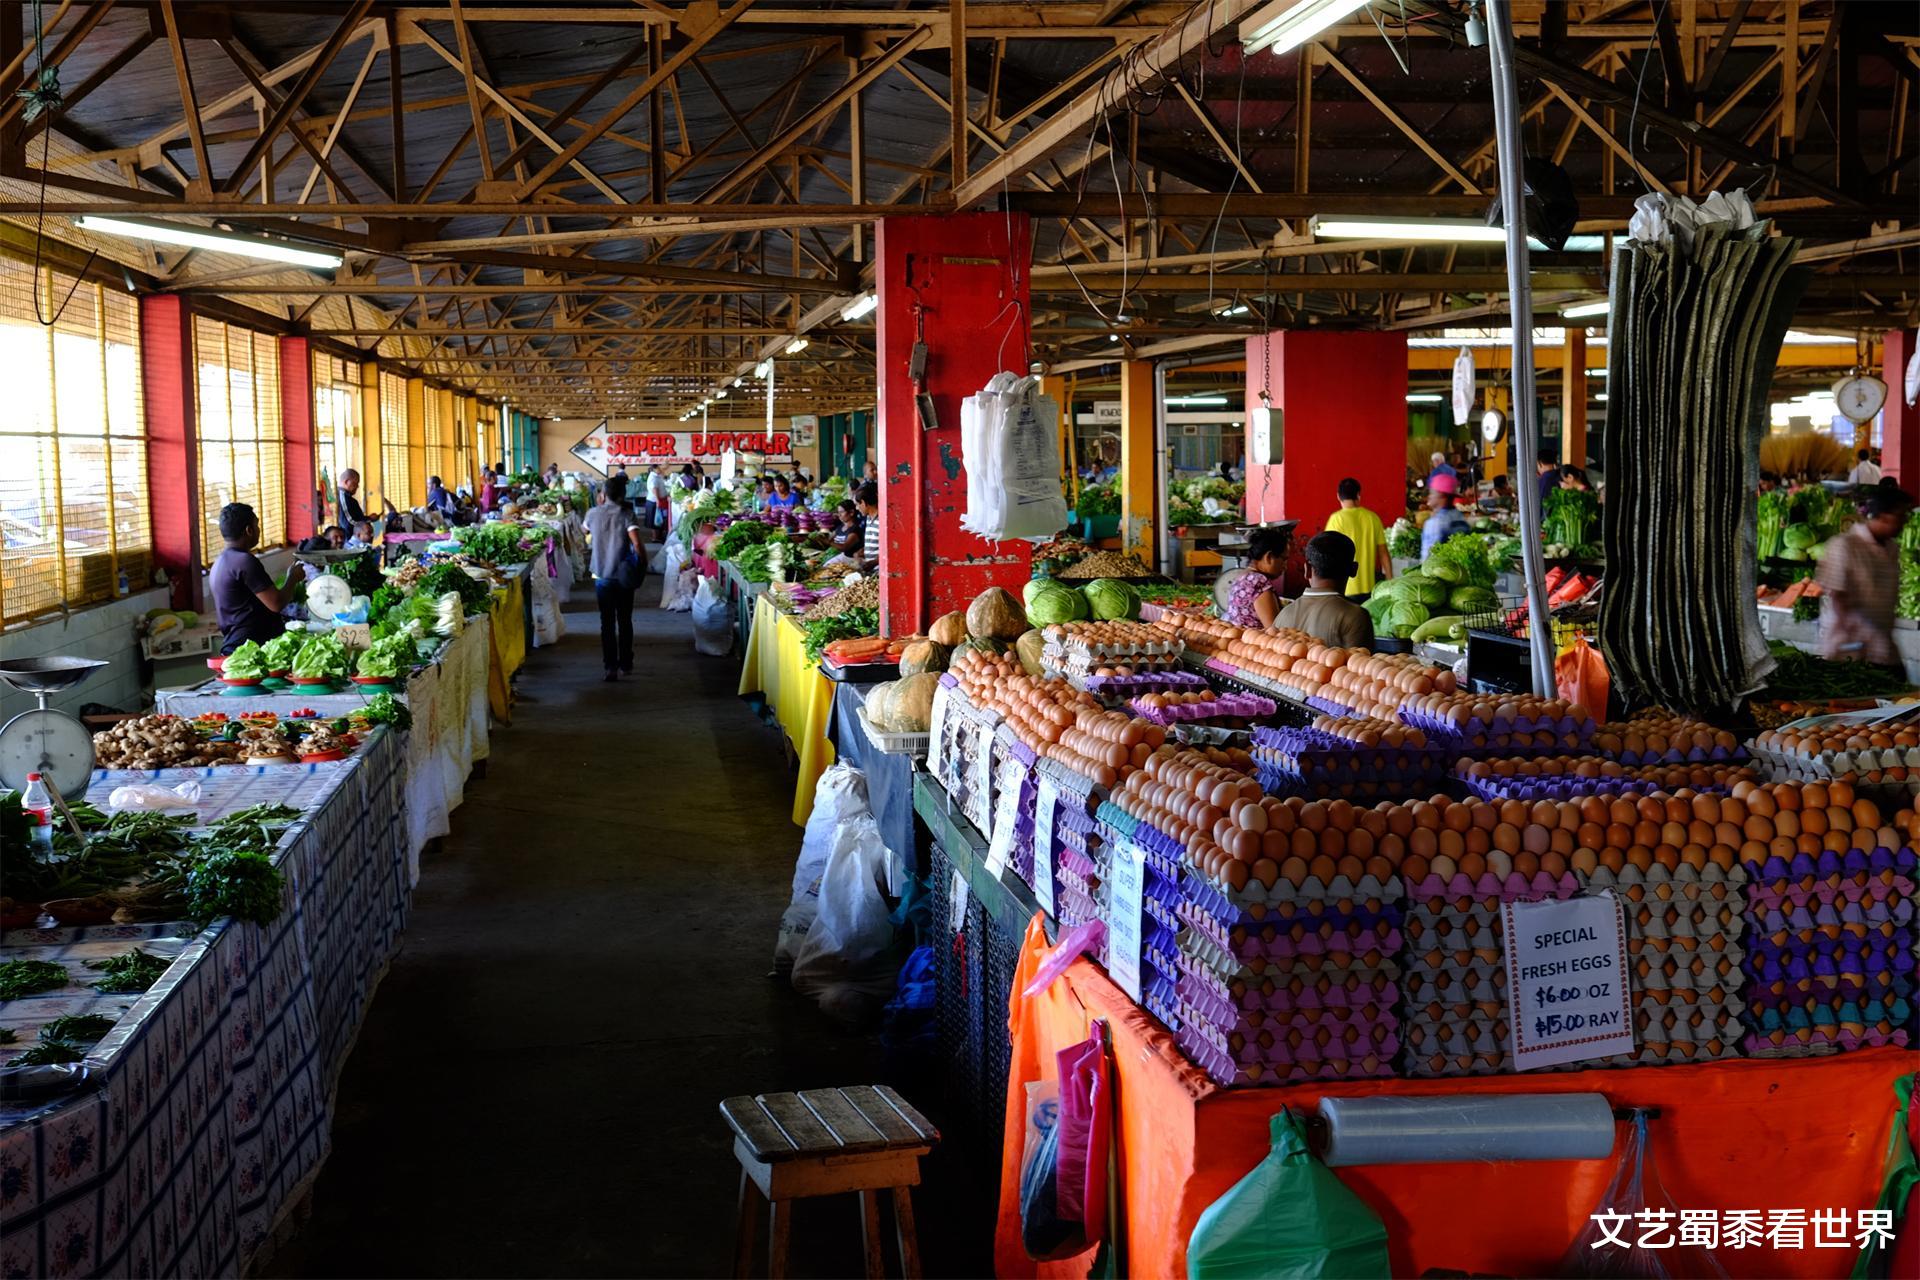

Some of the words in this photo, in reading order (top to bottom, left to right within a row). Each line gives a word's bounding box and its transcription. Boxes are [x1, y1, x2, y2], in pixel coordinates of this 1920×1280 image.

[607, 433, 677, 456] SUPER
[691, 432, 791, 456] BUTCHER
[1534, 926, 1598, 950] SPECIAL
[1522, 960, 1567, 981] FRESH
[1571, 954, 1612, 973] EGGS
[1536, 985, 1581, 1009] $6.00
[1586, 983, 1610, 998] OZ
[1535, 1014, 1585, 1038] $15.00
[1589, 1010, 1619, 1027] RAY
